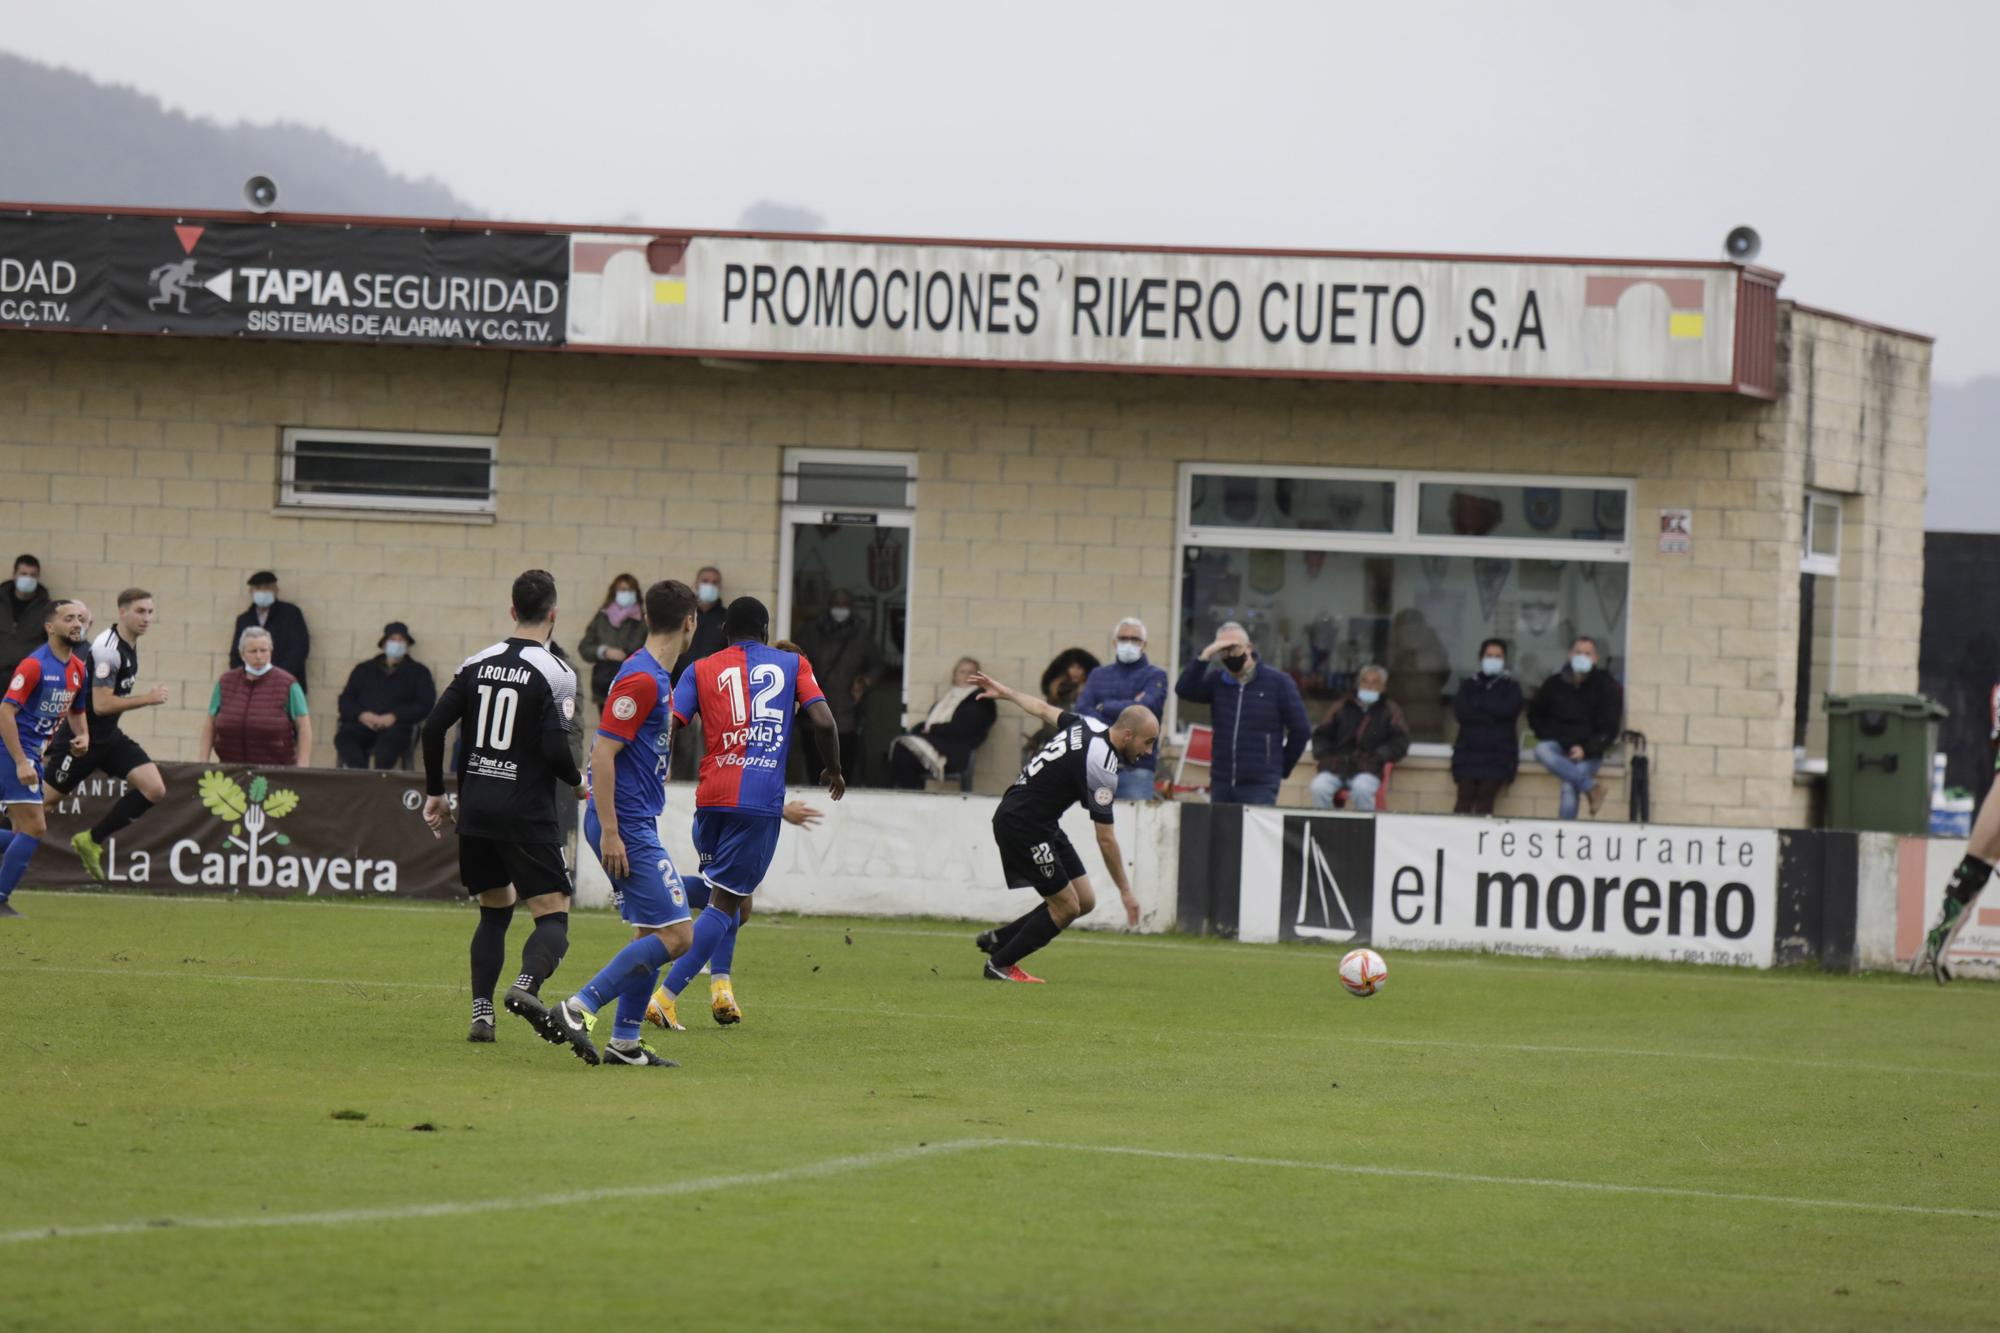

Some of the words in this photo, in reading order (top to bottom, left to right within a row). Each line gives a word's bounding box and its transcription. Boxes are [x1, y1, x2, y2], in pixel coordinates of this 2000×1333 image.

[240, 267, 349, 306] TAPIA
[352, 273, 559, 314] SEGURIDAD
[722, 263, 1040, 336] PROMOCIONES
[1259, 281, 1426, 348] CUETO
[247, 310, 349, 335] SISTEMAS
[352, 315, 380, 335] DE
[382, 316, 463, 338] ALARMA
[465, 319, 480, 339] Y
[477, 664, 531, 685] I.ROLDÁN
[717, 664, 785, 727] 12
[476, 684, 519, 751] 10
[61, 755, 73, 771] 6
[726, 754, 778, 769] Boprisa
[108, 837, 151, 882] La
[169, 839, 398, 895] Carbayera
[1031, 842, 1054, 865] 22
[1477, 829, 1754, 867] restaurante
[1391, 848, 1445, 926] el
[1475, 870, 1755, 940] moreno
